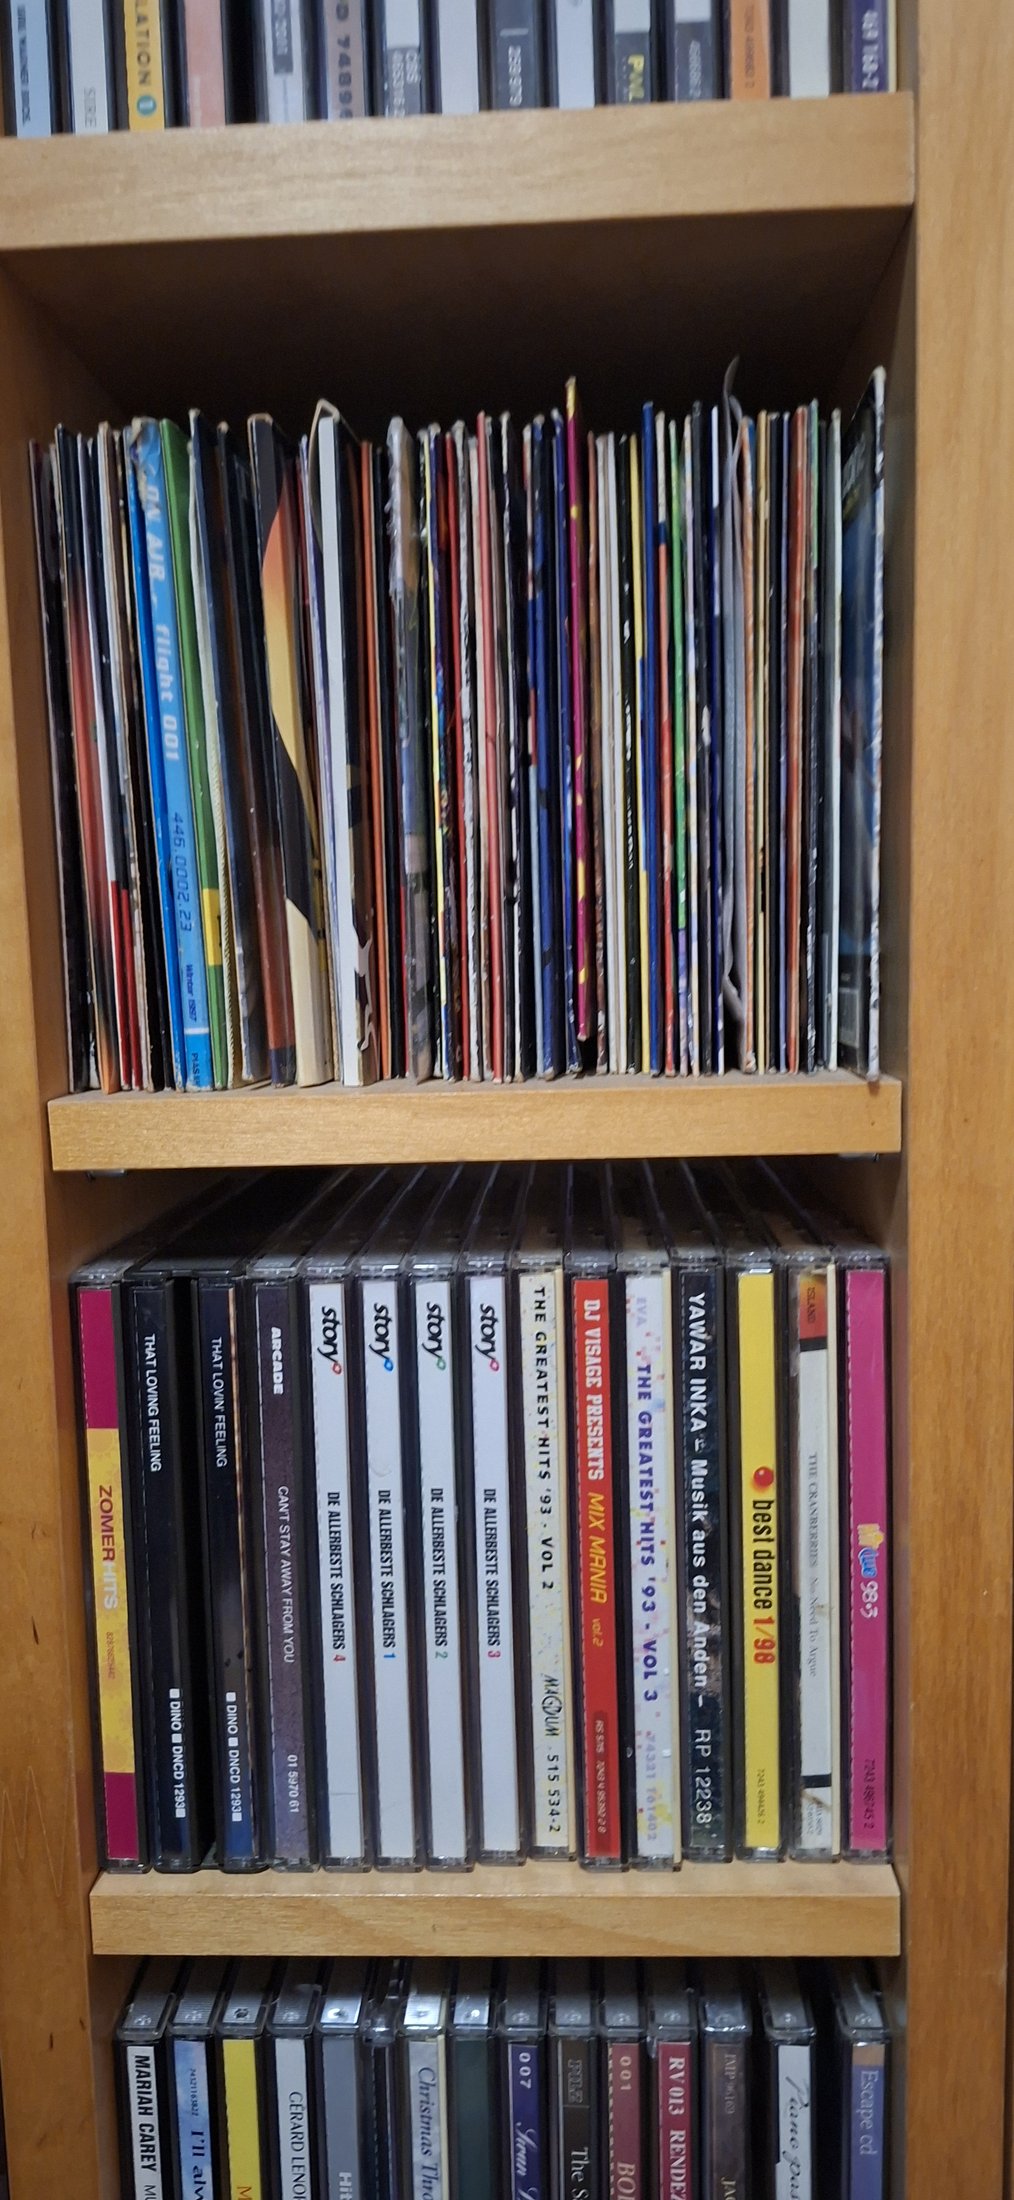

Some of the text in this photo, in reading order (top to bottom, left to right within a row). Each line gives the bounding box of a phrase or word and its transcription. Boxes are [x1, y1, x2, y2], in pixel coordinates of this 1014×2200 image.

[84, 87, 97, 128] SIRE
[155, 624, 174, 702] flight
[162, 714, 180, 762] 001
[368, 1303, 394, 1371] story
[422, 1301, 446, 1370] story
[475, 1303, 500, 1371] story
[806, 1286, 816, 1324] ISLAND
[271, 1327, 284, 1395] ARCADE
[316, 1305, 343, 1375] story
[144, 1334, 161, 1472] THAT LOVING FEELING
[211, 1337, 227, 1468] THAT LOVIN' FEELING
[534, 1286, 554, 1590] THE GREATEST HITS '93 VOL 2
[808, 1453, 818, 1478] THE
[327, 1492, 340, 1505] DE
[378, 1489, 390, 1504] DE
[483, 1488, 496, 1503] DE
[584, 1299, 607, 1648] DJ VISAGE PRESENTS MIX MANIA vol.2
[687, 1292, 711, 1687] YAWAR INKA Musik aus den Anden
[329, 1510, 343, 1579] ALLERBESTE
[378, 1508, 394, 1577] ALLERBESTE
[484, 1507, 499, 1576] ALLERBESTE
[637, 1363, 658, 1702] THE GREATEST HITS '93 VOL 3
[808, 1482, 818, 1568] CRANBERRIES
[277, 1486, 295, 1664] CAN'T STAY AWAY FROM YOU
[430, 1488, 448, 1659] DE ALLERBESTE SCHLAGERS 2
[752, 1499, 775, 1664] best dance 1/98
[331, 1583, 346, 1650] SCHLAGERS
[380, 1581, 396, 1648] SCHLAGERS
[486, 1580, 500, 1647] SCHLAGERS
[170, 1700, 182, 1731] DINO
[226, 1704, 238, 1735] DINO
[695, 1729, 711, 1758] RP
[172, 1745, 184, 1780] DNCD
[228, 1749, 241, 1784] DNCD
[287, 1754, 297, 1769] 01
[547, 1754, 561, 1833] 515 534-2
[135, 2055, 154, 2116] MARIAH
[518, 2052, 532, 2089] 007
[620, 2056, 632, 2091] 001
[668, 2055, 685, 2083] RV
[668, 2087, 685, 2115] 013
[191, 2130, 206, 2158] I'll
[418, 2066, 438, 2155] Christmas
[785, 2076, 809, 2150] Piano
[855, 2069, 879, 2155] Escape cd
[138, 2123, 157, 2172] CAREY
[570, 2147, 590, 2182] The
